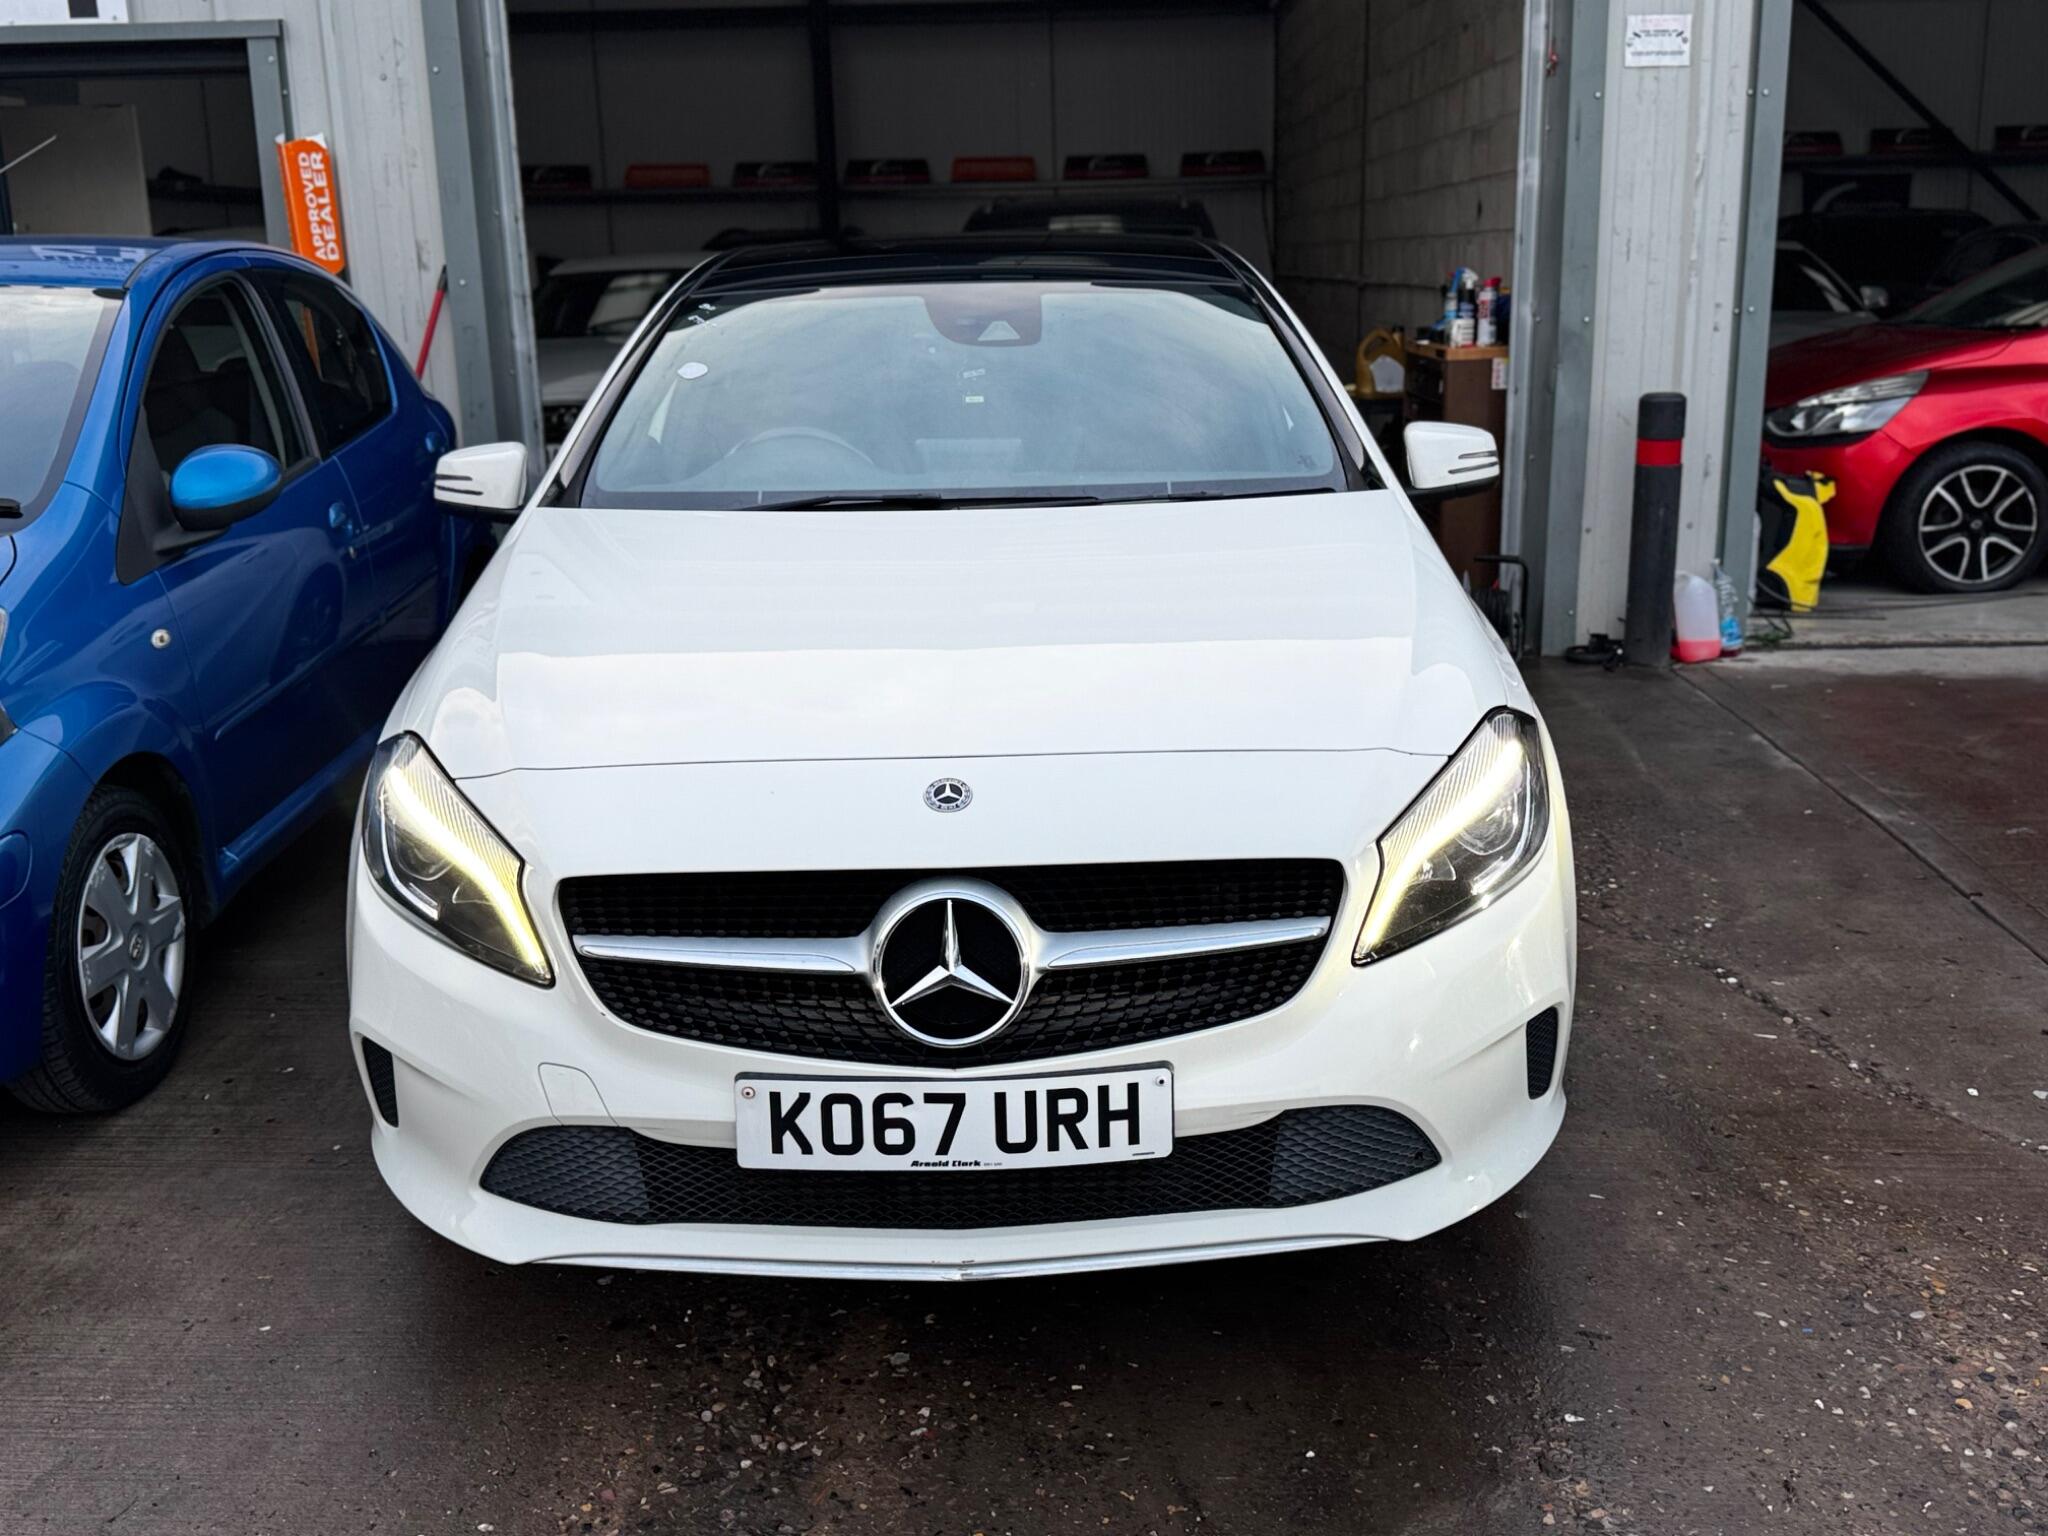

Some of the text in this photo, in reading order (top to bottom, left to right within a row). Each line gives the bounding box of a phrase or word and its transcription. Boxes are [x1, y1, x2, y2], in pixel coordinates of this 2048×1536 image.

[298, 152, 327, 260] APPROVED
[310, 151, 340, 261] DEALER
[769, 1082, 1140, 1156] KO67 URH
